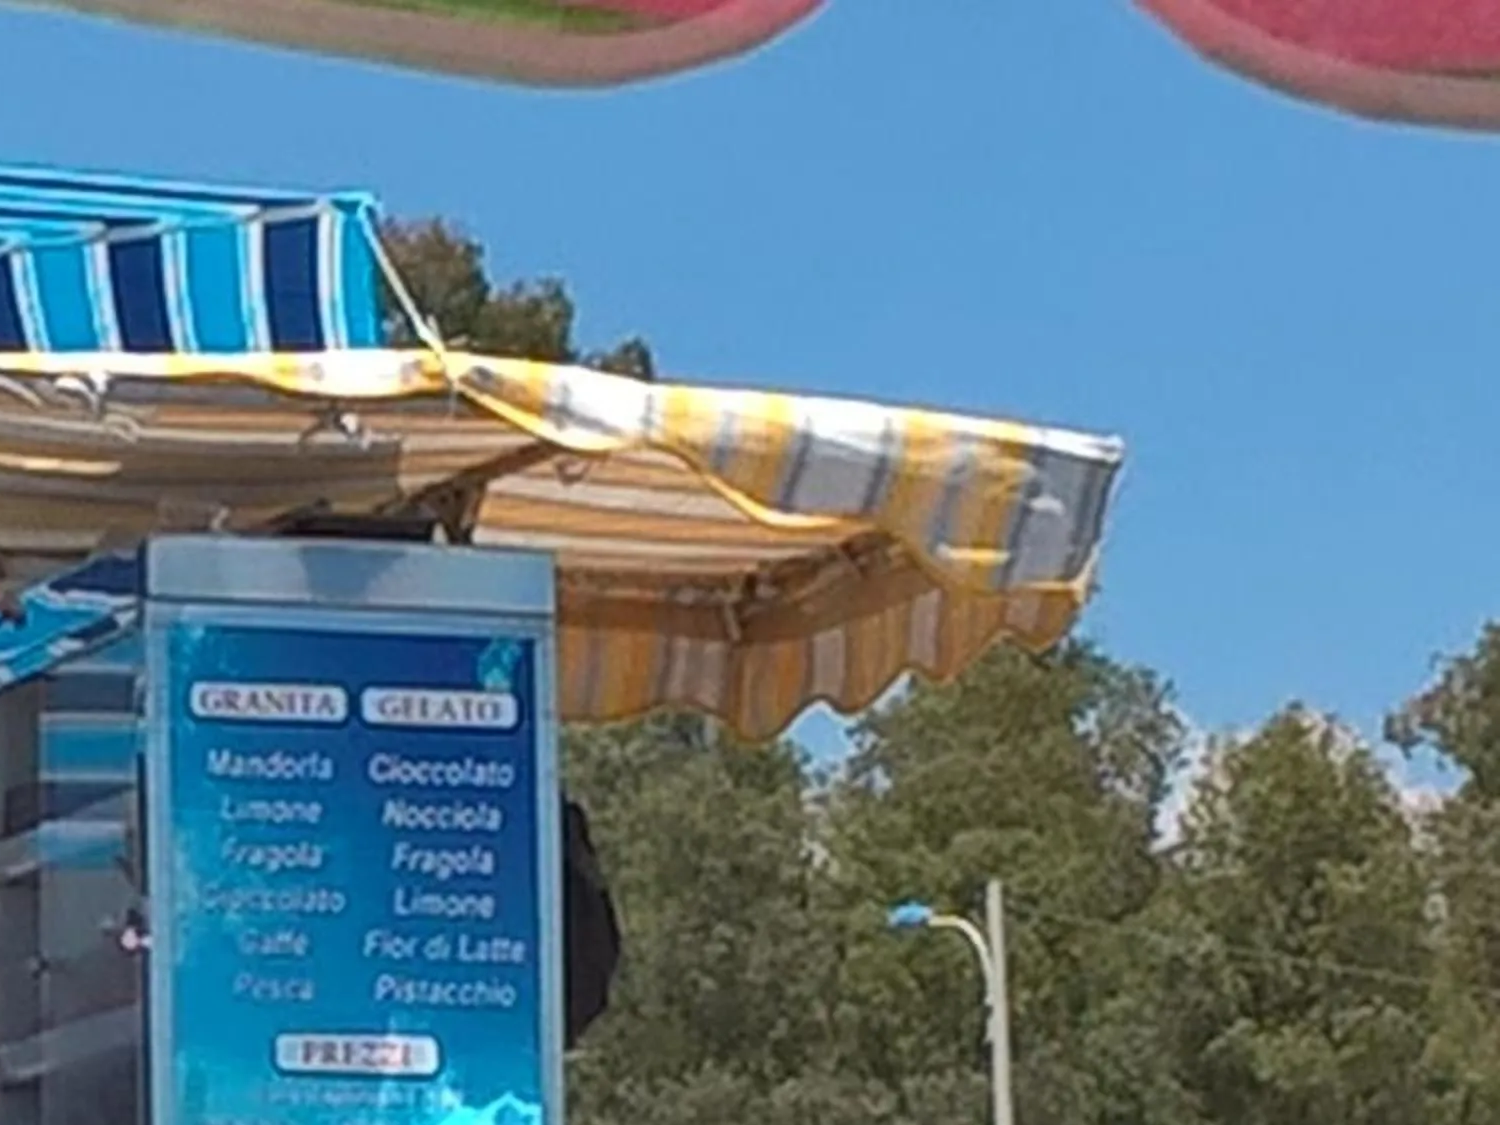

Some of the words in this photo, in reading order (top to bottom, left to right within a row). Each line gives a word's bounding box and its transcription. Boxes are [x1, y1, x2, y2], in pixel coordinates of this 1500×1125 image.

[200, 691, 336, 717] GRANITA
[377, 698, 500, 722] GELATO
[207, 749, 333, 779] Mandorla
[368, 753, 515, 788] Cioccolato
[221, 796, 322, 823] Limone
[382, 799, 502, 831] Nocciola
[222, 836, 322, 872] Fragola
[391, 841, 494, 879] Fragola
[394, 887, 495, 919] Limone
[363, 929, 417, 959] Fior
[424, 934, 450, 960] di
[458, 934, 525, 963] Latte
[233, 972, 314, 1000] Pesca
[375, 973, 516, 1007] Pistacchio
[302, 1040, 411, 1067] PREZZI
